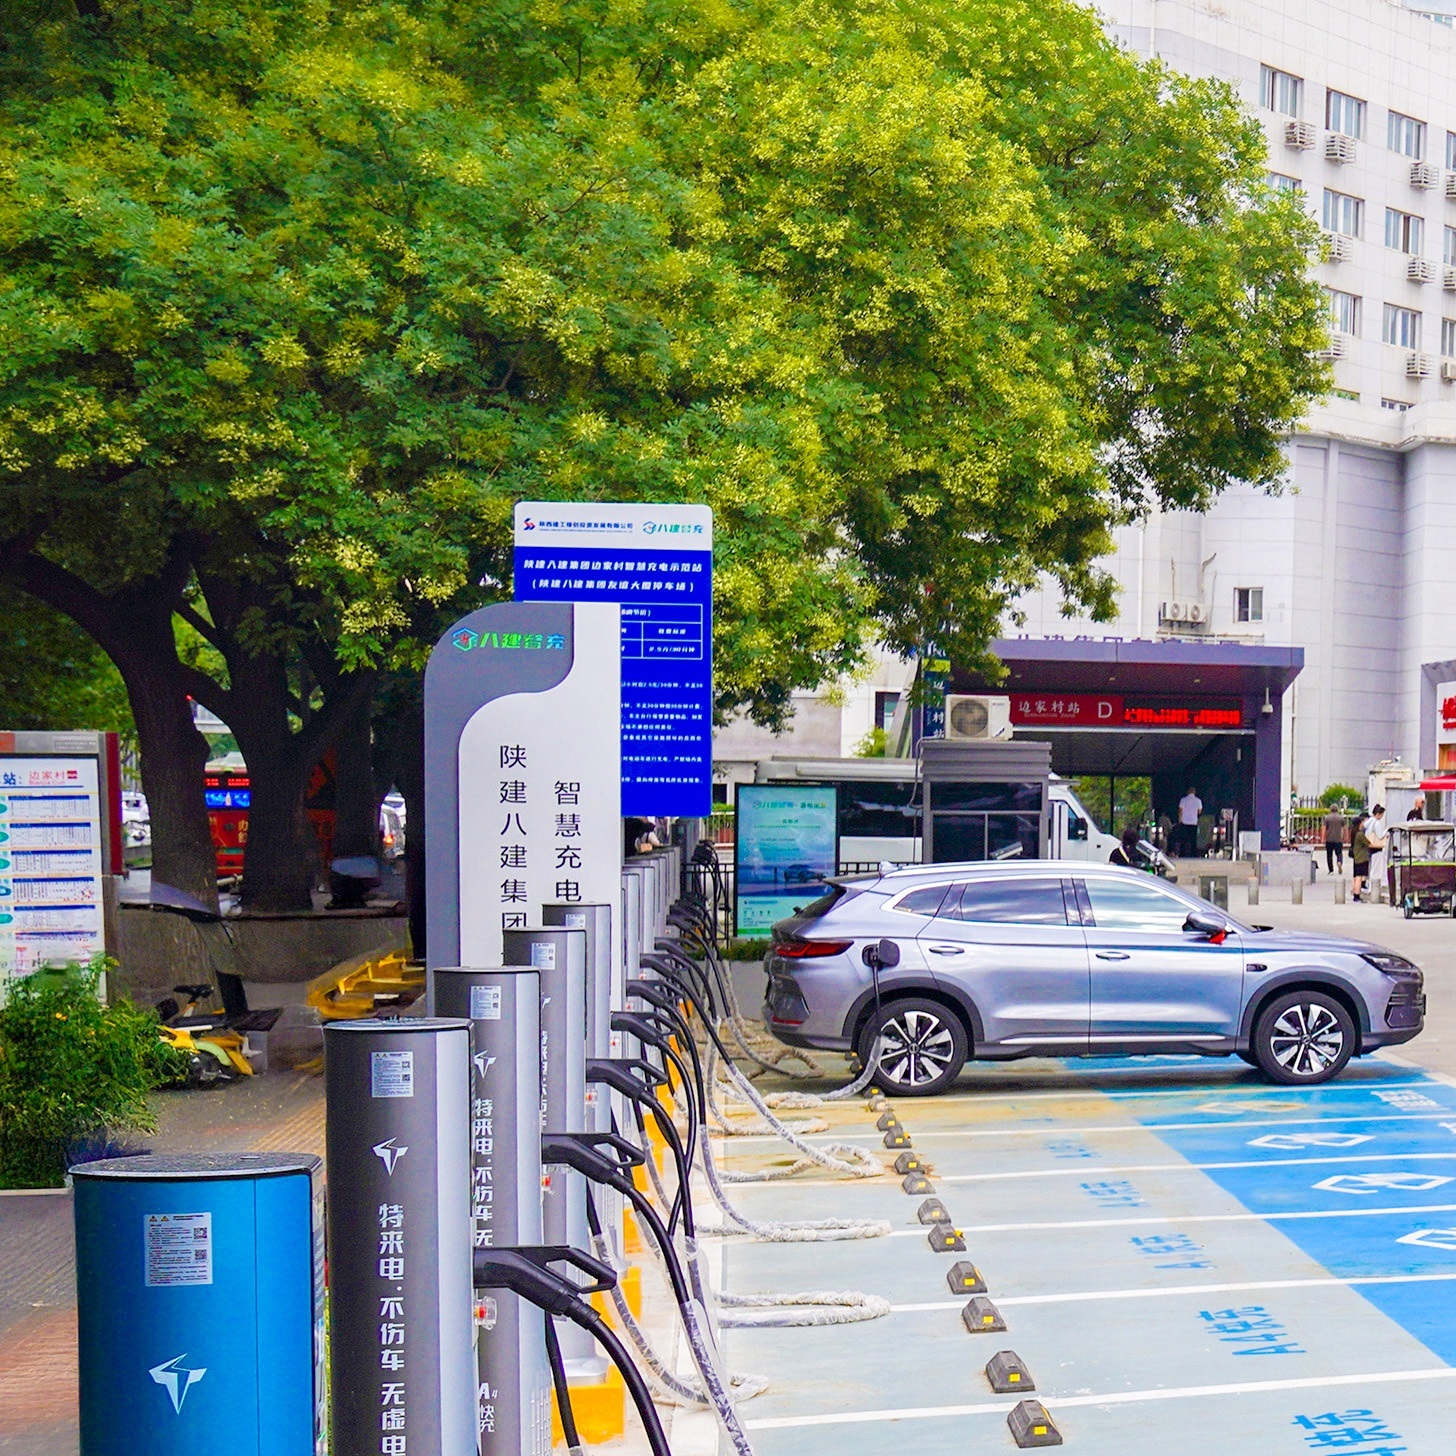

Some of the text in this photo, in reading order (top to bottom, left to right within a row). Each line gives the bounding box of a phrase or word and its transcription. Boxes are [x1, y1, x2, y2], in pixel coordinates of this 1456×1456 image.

[480, 632, 566, 650] 八建智充
[1018, 701, 1081, 714] 边家村站
[1097, 702, 1113, 719] D
[499, 744, 528, 929] 陕建八建集团
[554, 780, 582, 902] 智慧充电
[1195, 1306, 1308, 1356] A4快充
